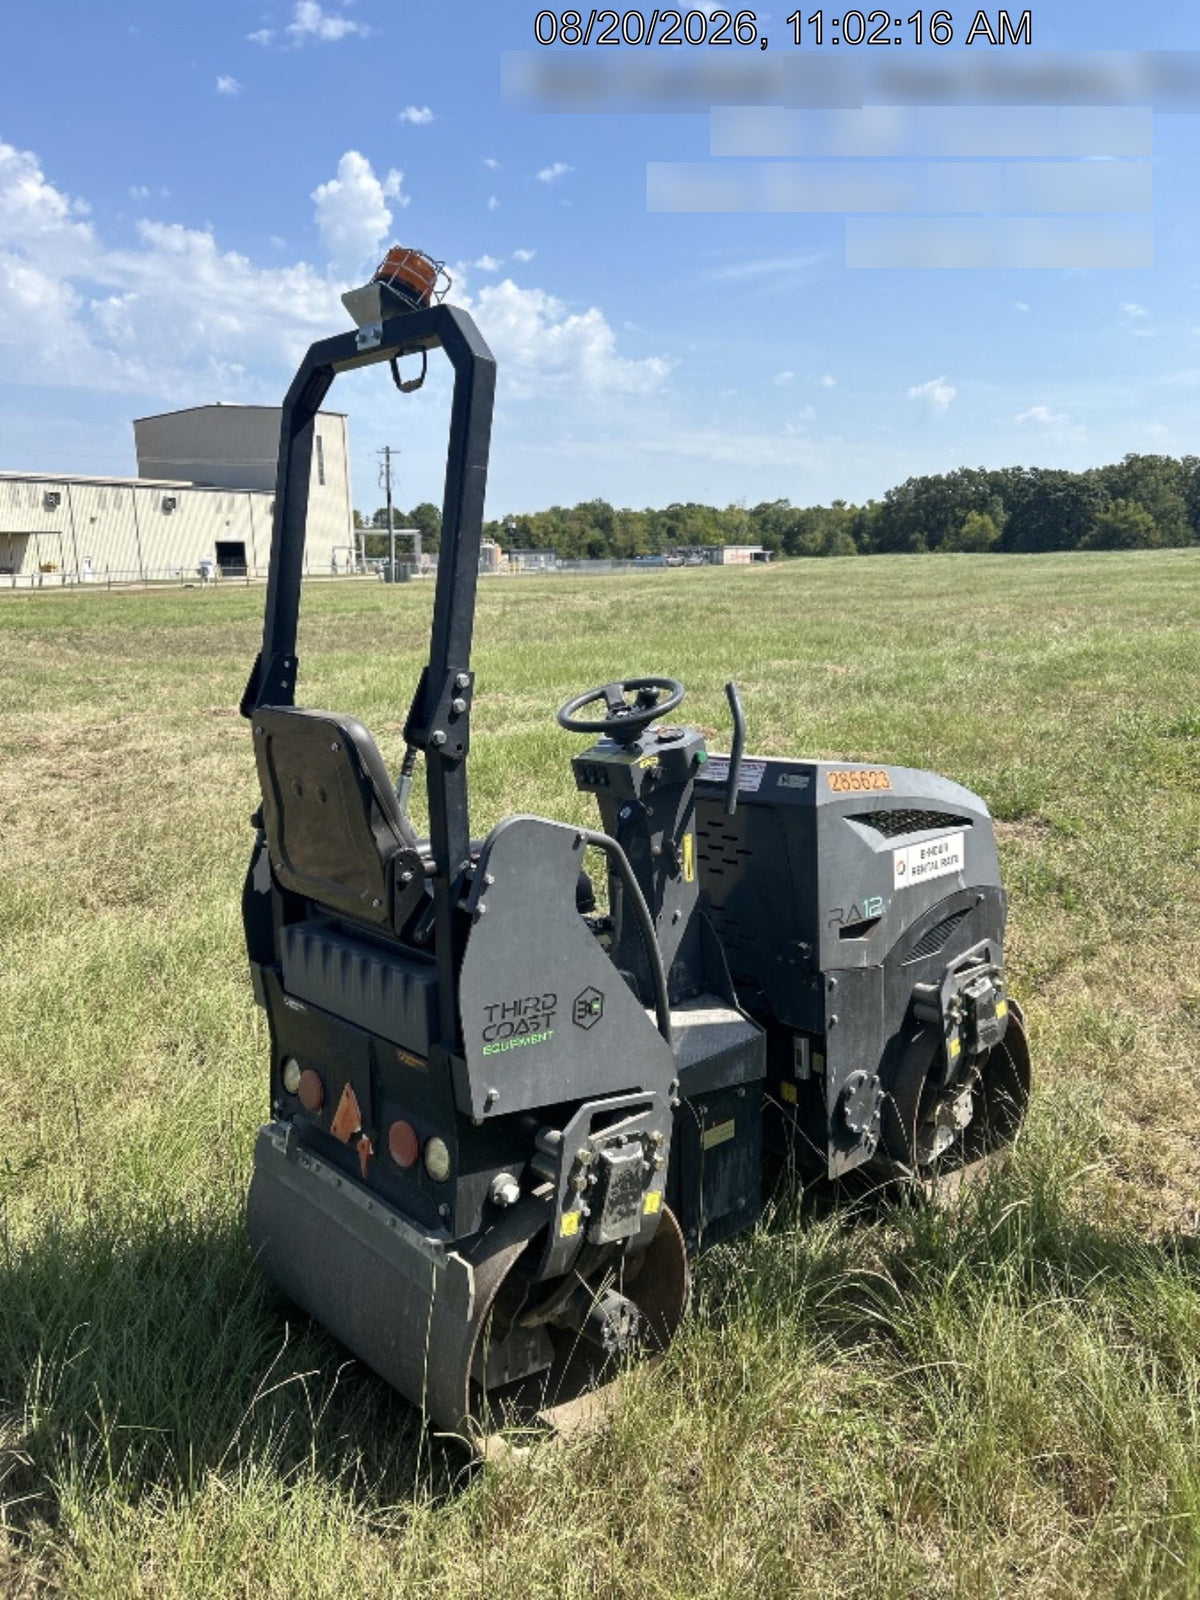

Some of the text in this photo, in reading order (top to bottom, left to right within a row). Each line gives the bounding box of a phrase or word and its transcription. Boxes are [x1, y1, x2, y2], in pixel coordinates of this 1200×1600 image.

[829, 771, 890, 792] 285623
[483, 993, 557, 1023] THIRD
[482, 1011, 557, 1042] COAST
[482, 1030, 555, 1056] EQUIPMENT
